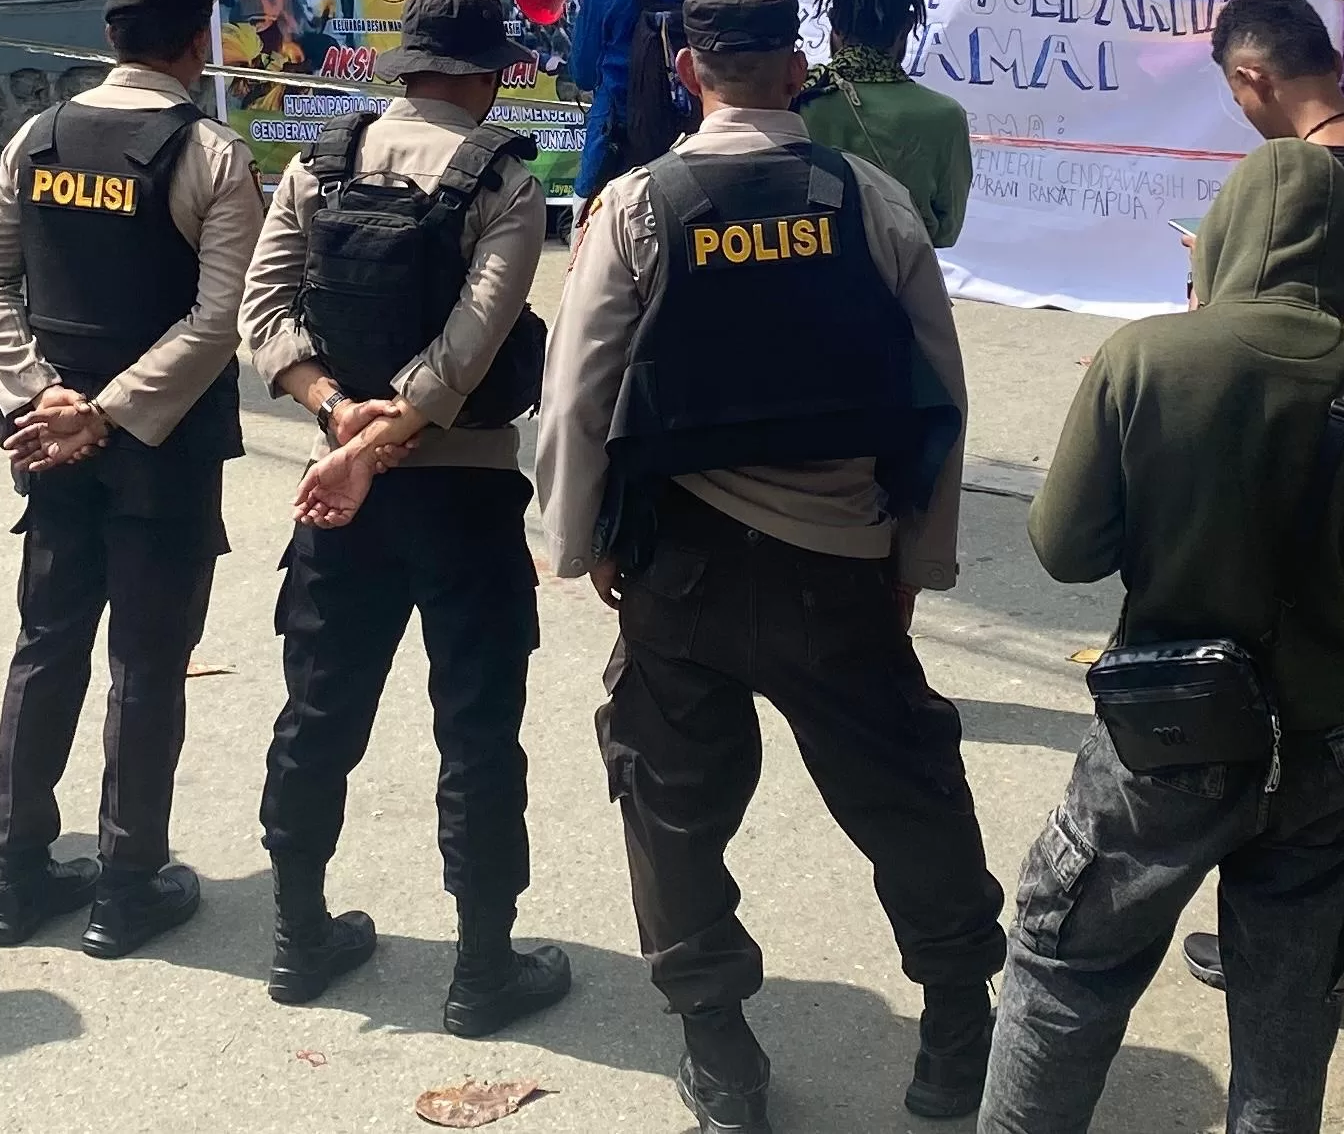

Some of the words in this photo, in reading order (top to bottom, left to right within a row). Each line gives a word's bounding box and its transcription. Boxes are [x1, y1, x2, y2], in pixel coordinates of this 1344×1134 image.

[321, 46, 377, 82] AKSI
[905, 22, 1119, 92] AMAI
[284, 95, 327, 116] HUTAN
[327, 97, 366, 116] PAPUA
[367, 98, 393, 116] DIB
[31, 168, 136, 213] POLISI
[1028, 182, 1077, 207] RAKYAT
[1081, 188, 1148, 220] PAPUA
[694, 217, 833, 266] POLISI
